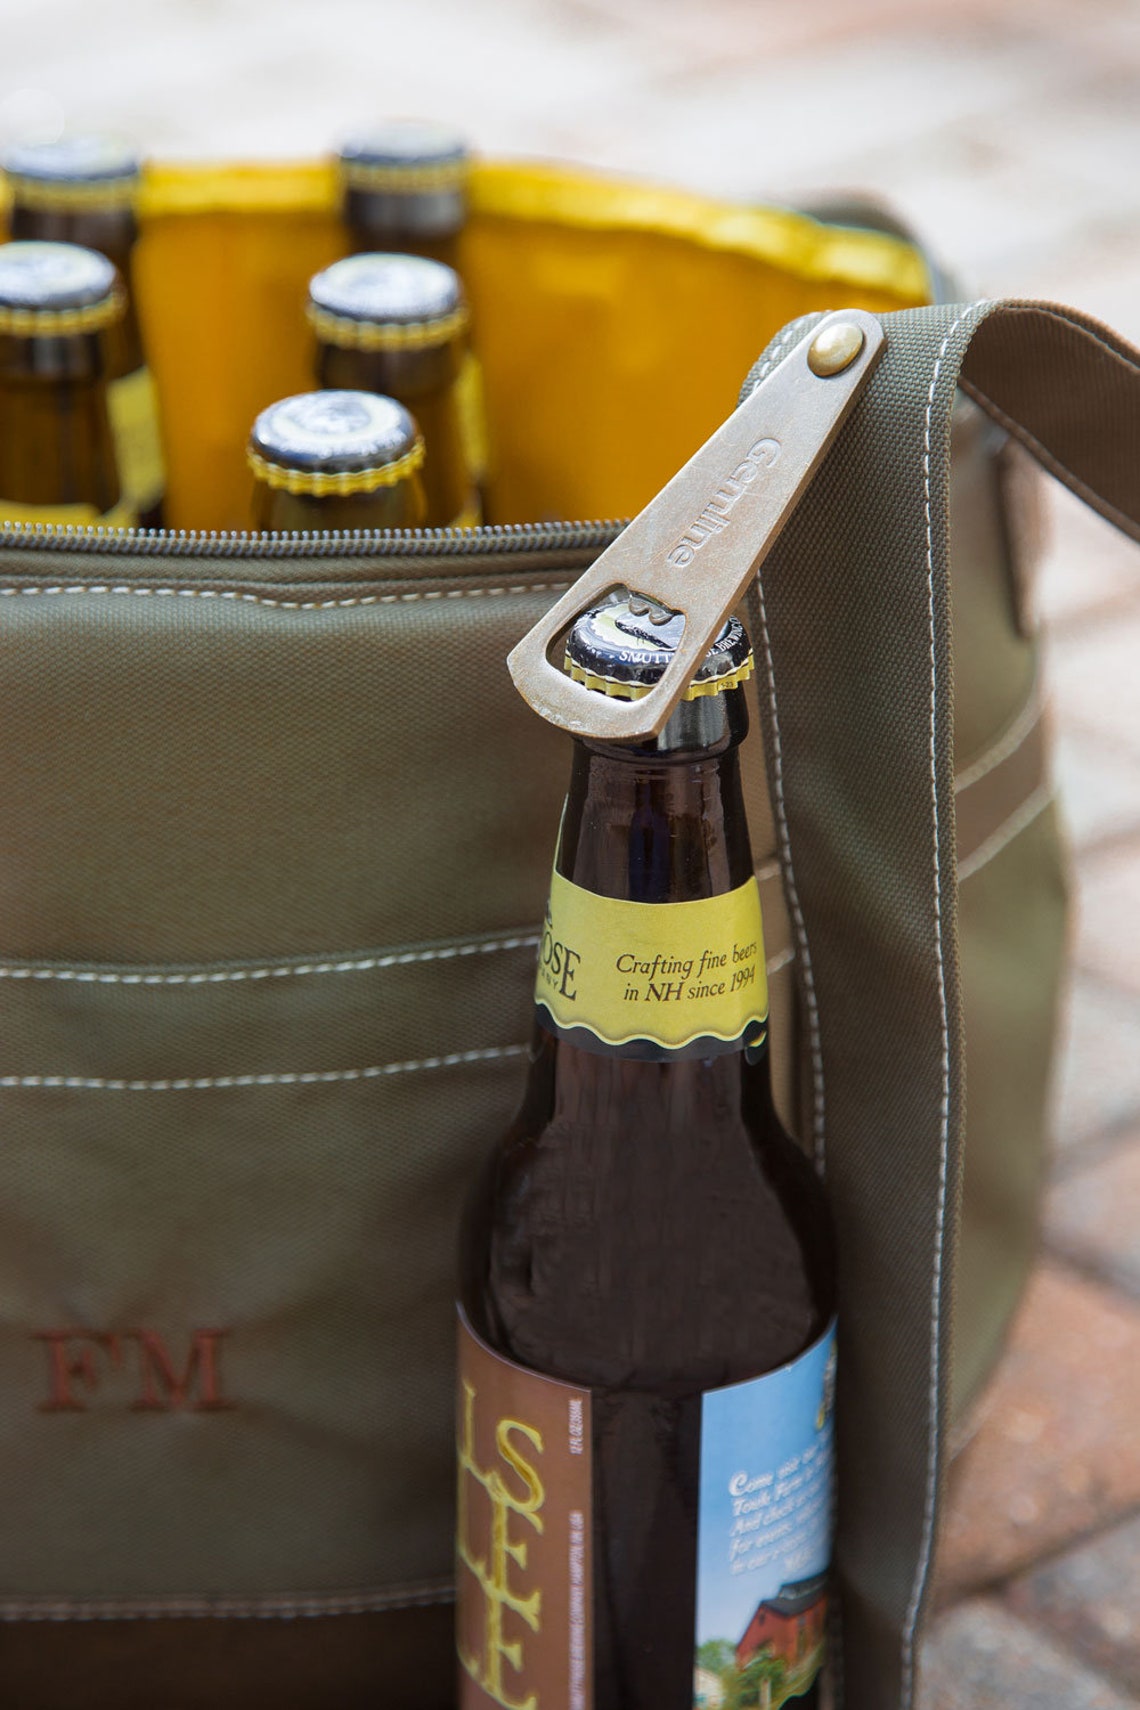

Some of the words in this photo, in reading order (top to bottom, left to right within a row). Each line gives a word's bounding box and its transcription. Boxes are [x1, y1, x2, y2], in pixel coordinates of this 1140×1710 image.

[667, 437, 782, 567] Gemline
[618, 650, 676, 664] SMUTT
[543, 931, 581, 1001] OSE
[616, 953, 693, 980] Crafting
[696, 950, 727, 978] fine
[732, 940, 757, 964] beers
[623, 982, 639, 1001] in
[643, 981, 684, 1002] NH
[687, 980, 725, 1000] since
[729, 964, 755, 993] 1994
